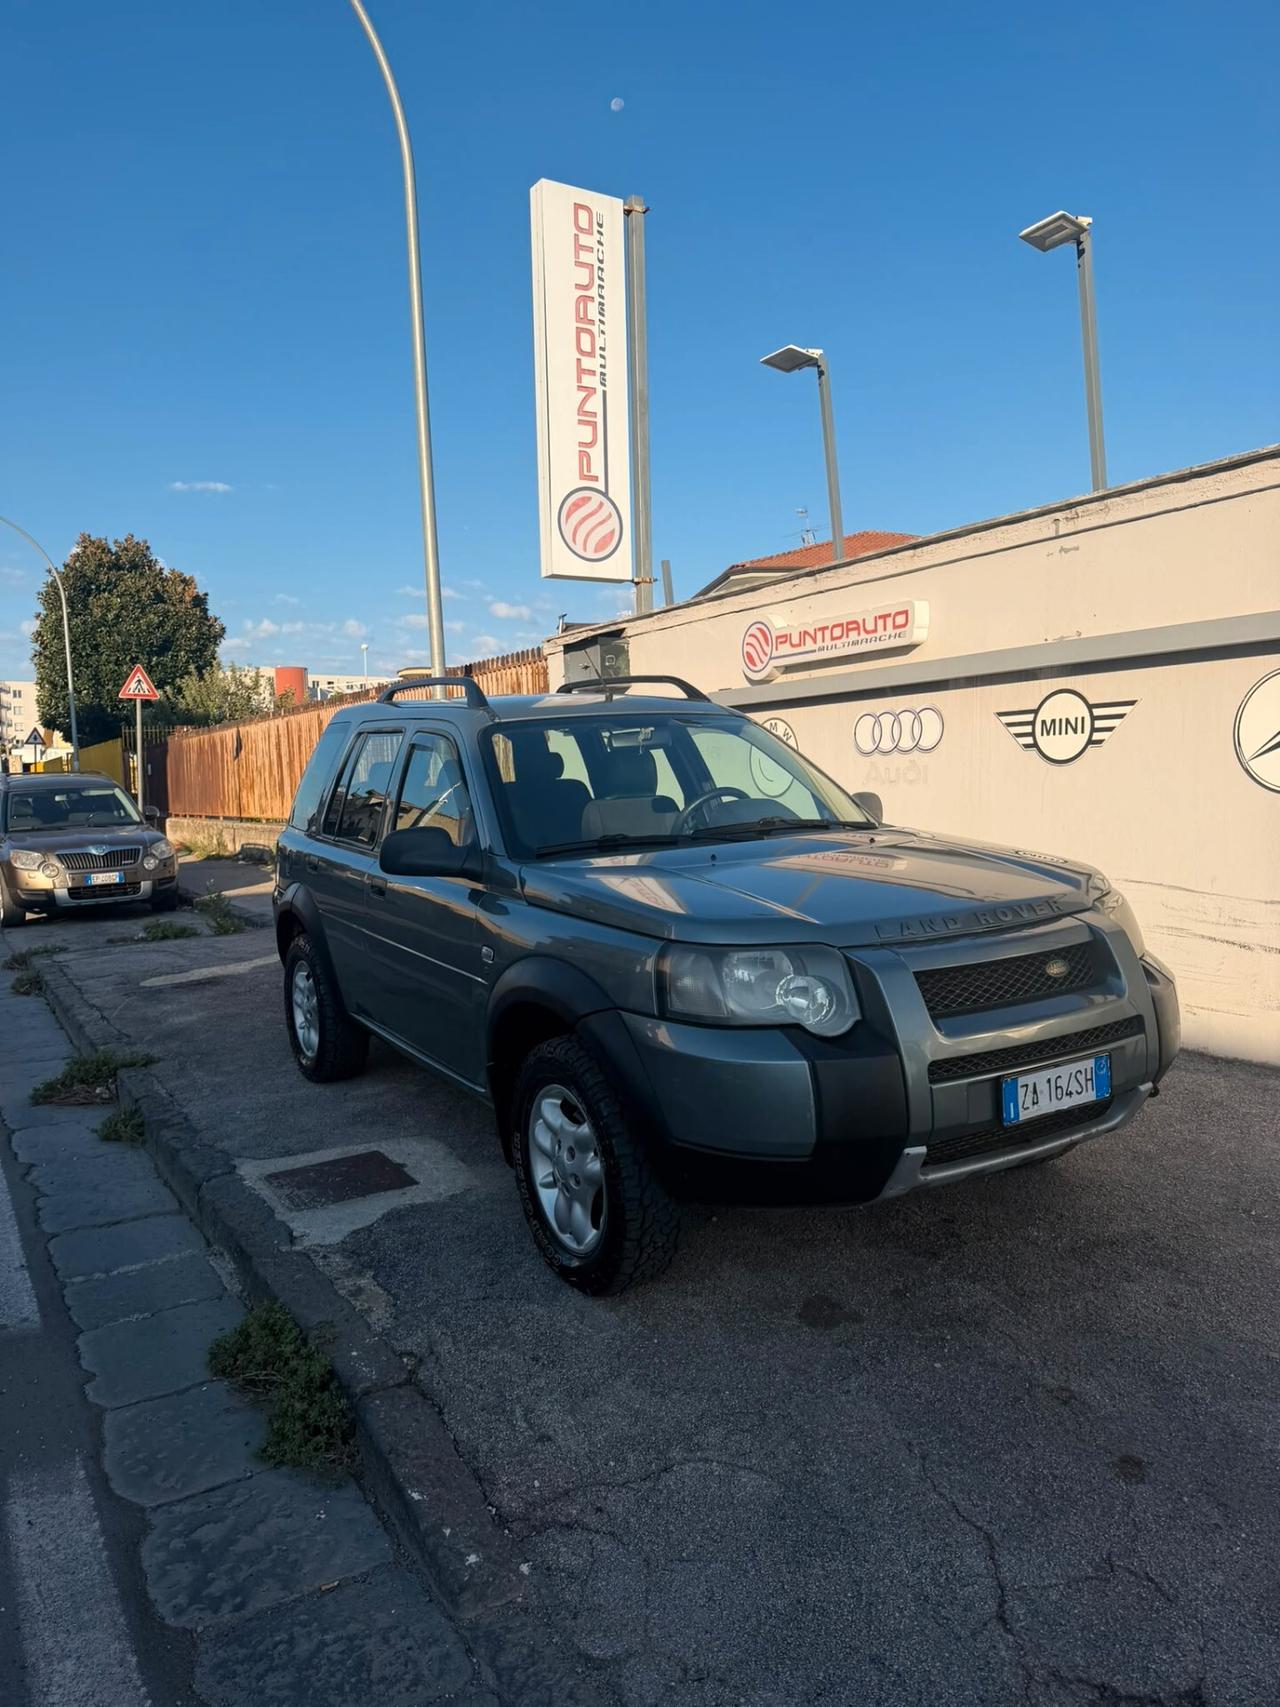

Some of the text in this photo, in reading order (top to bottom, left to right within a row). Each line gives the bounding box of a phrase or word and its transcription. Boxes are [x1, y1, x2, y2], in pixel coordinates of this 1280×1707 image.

[596, 211, 607, 388] MULTIMARCHE
[574, 202, 599, 482] PUNTOAUTO
[775, 609, 909, 652] PUNTOAUTO
[816, 631, 908, 653] MULTIMARCHE
[1041, 716, 1085, 736] MINI
[874, 900, 1066, 940] LAND ROVER
[1047, 1066, 1094, 1102] 164SH
